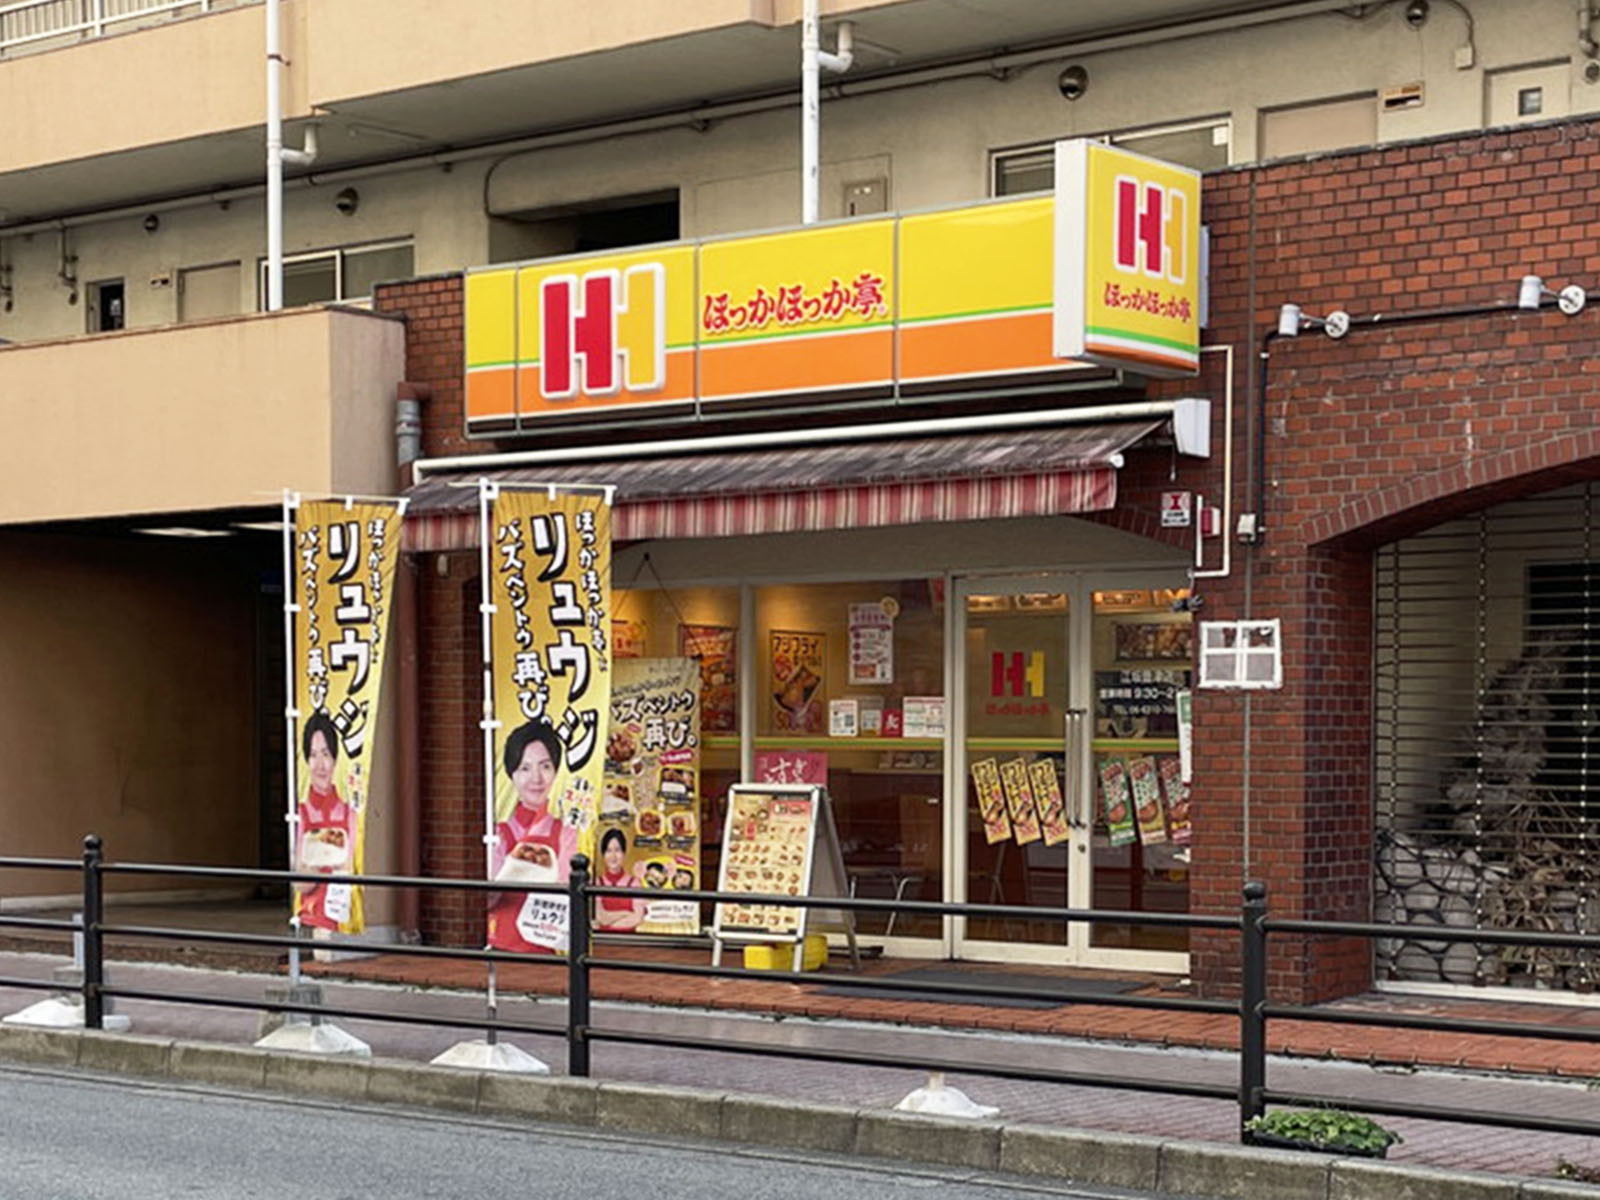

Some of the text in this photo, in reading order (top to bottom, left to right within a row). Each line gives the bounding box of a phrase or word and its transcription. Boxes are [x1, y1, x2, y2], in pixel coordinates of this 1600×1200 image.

[703, 273, 886, 331] ほっかほっか亭
[1104, 281, 1191, 322] ほっかほっか亭
[327, 521, 371, 760] リュウジ
[531, 511, 599, 773] リュウジ
